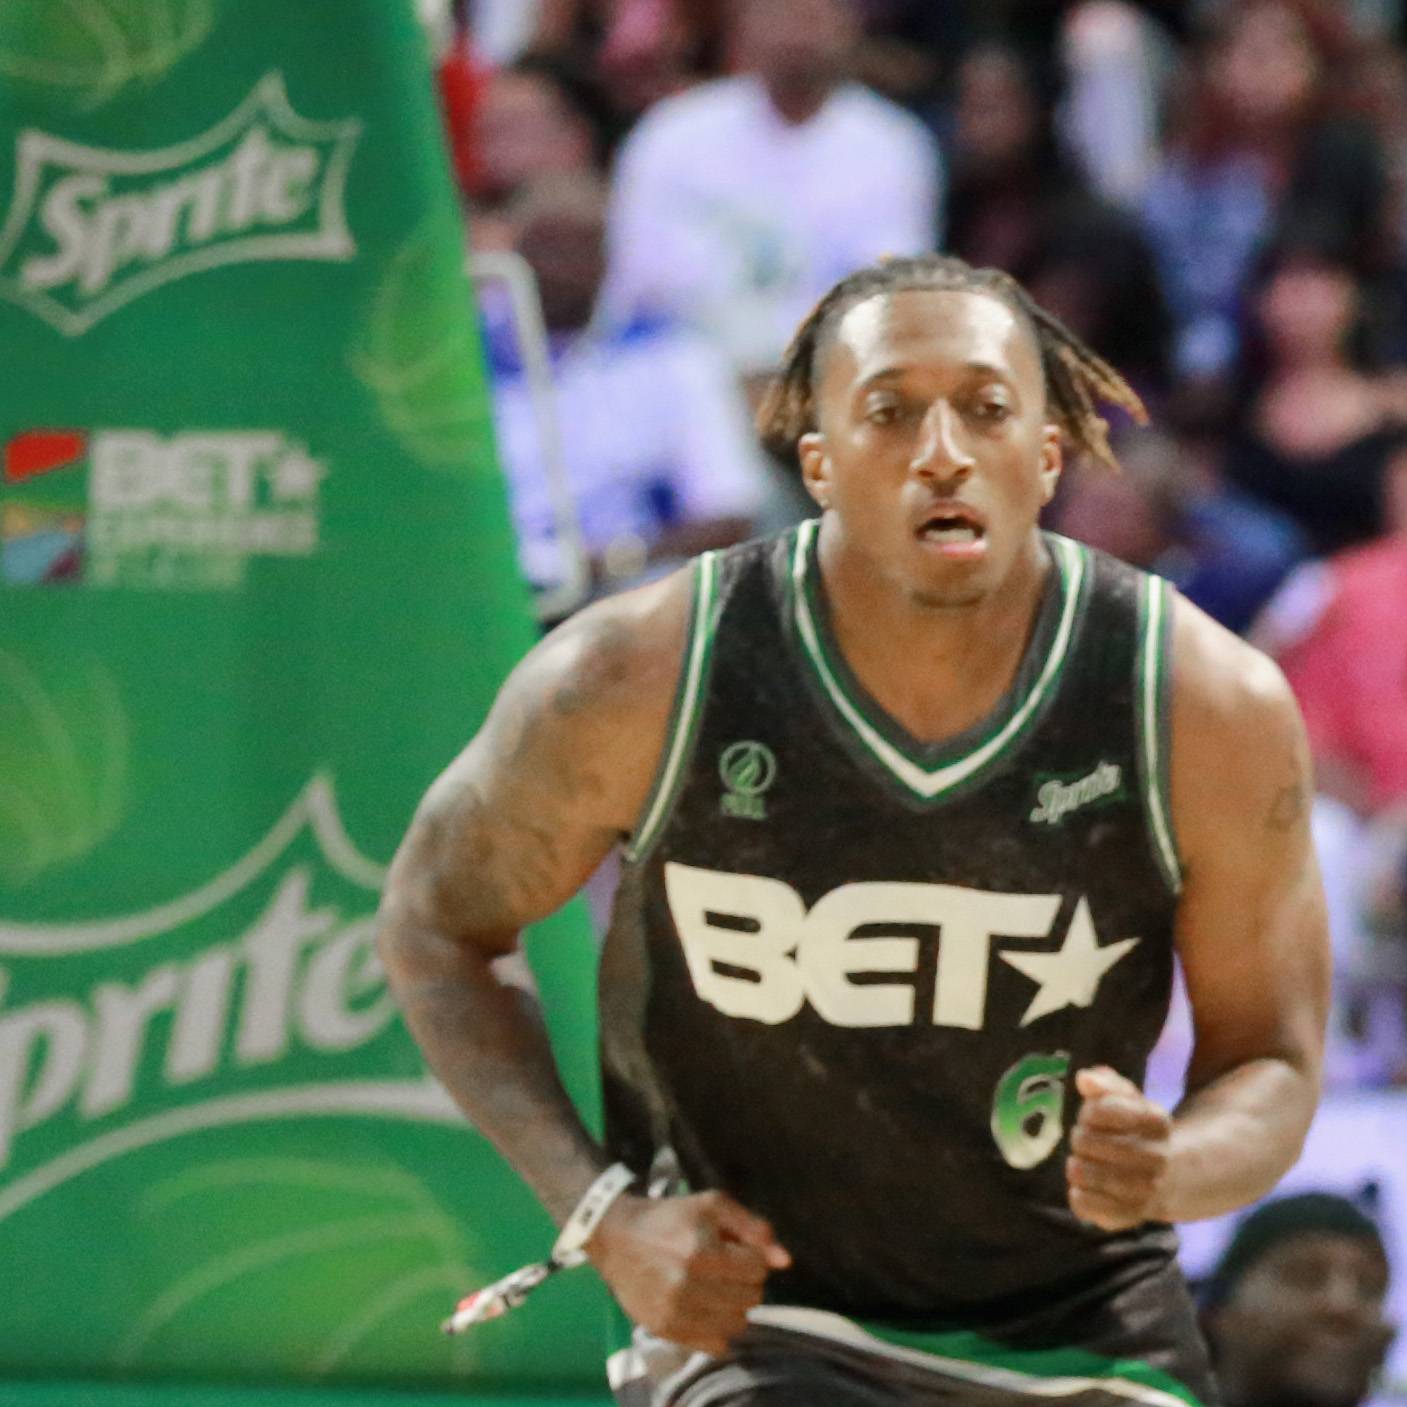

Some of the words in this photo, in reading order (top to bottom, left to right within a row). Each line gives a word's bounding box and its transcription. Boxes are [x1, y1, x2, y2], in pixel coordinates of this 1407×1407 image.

[18, 127, 319, 296] Sprite
[0, 867, 400, 1172] prite
[664, 862, 1063, 1030] BET
[990, 1051, 1072, 1170] 6
